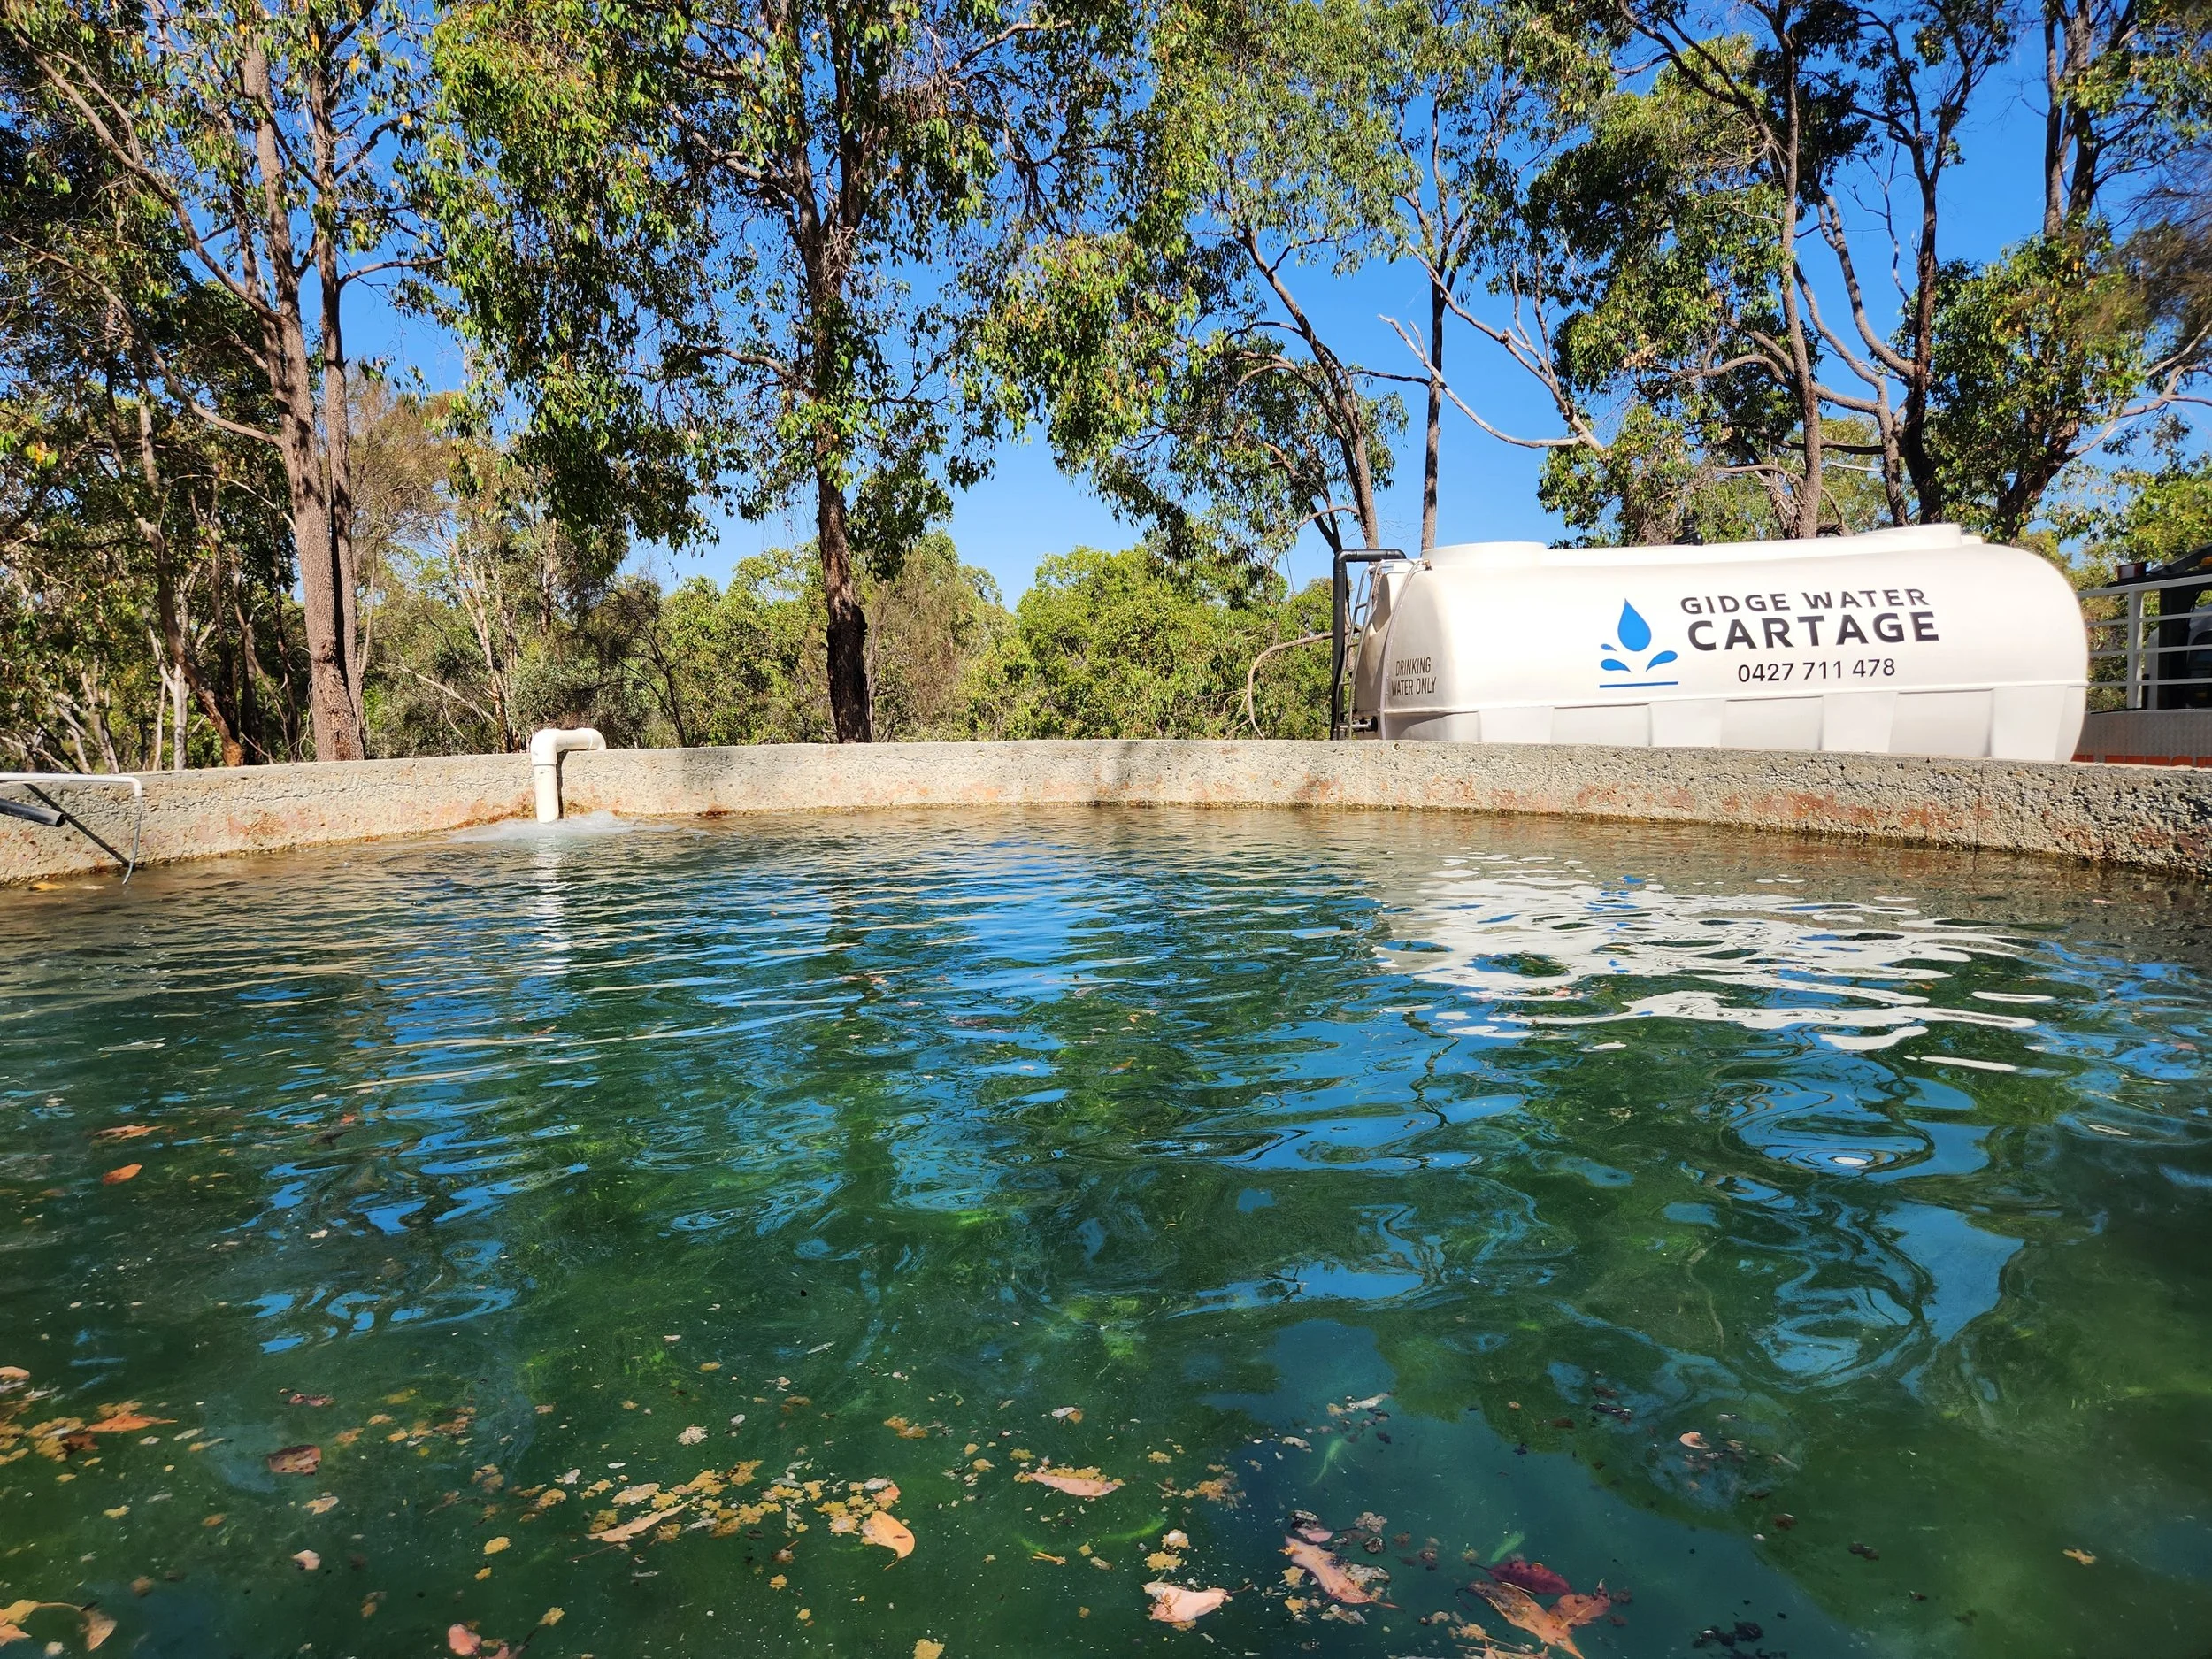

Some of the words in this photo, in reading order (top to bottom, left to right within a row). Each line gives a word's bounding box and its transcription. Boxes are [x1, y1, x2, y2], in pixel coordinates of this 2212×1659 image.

[1680, 593, 1791, 615] GIDGE
[1801, 588, 1930, 610] WATER
[1687, 611, 1939, 651] CARTAGE
[1395, 657, 1431, 676] DRINKING
[1738, 663, 1794, 682] 0427
[1802, 660, 1841, 680] 711
[1852, 657, 1895, 678] 478
[1392, 679, 1413, 696] WATER
[1416, 676, 1437, 694] ONLY
